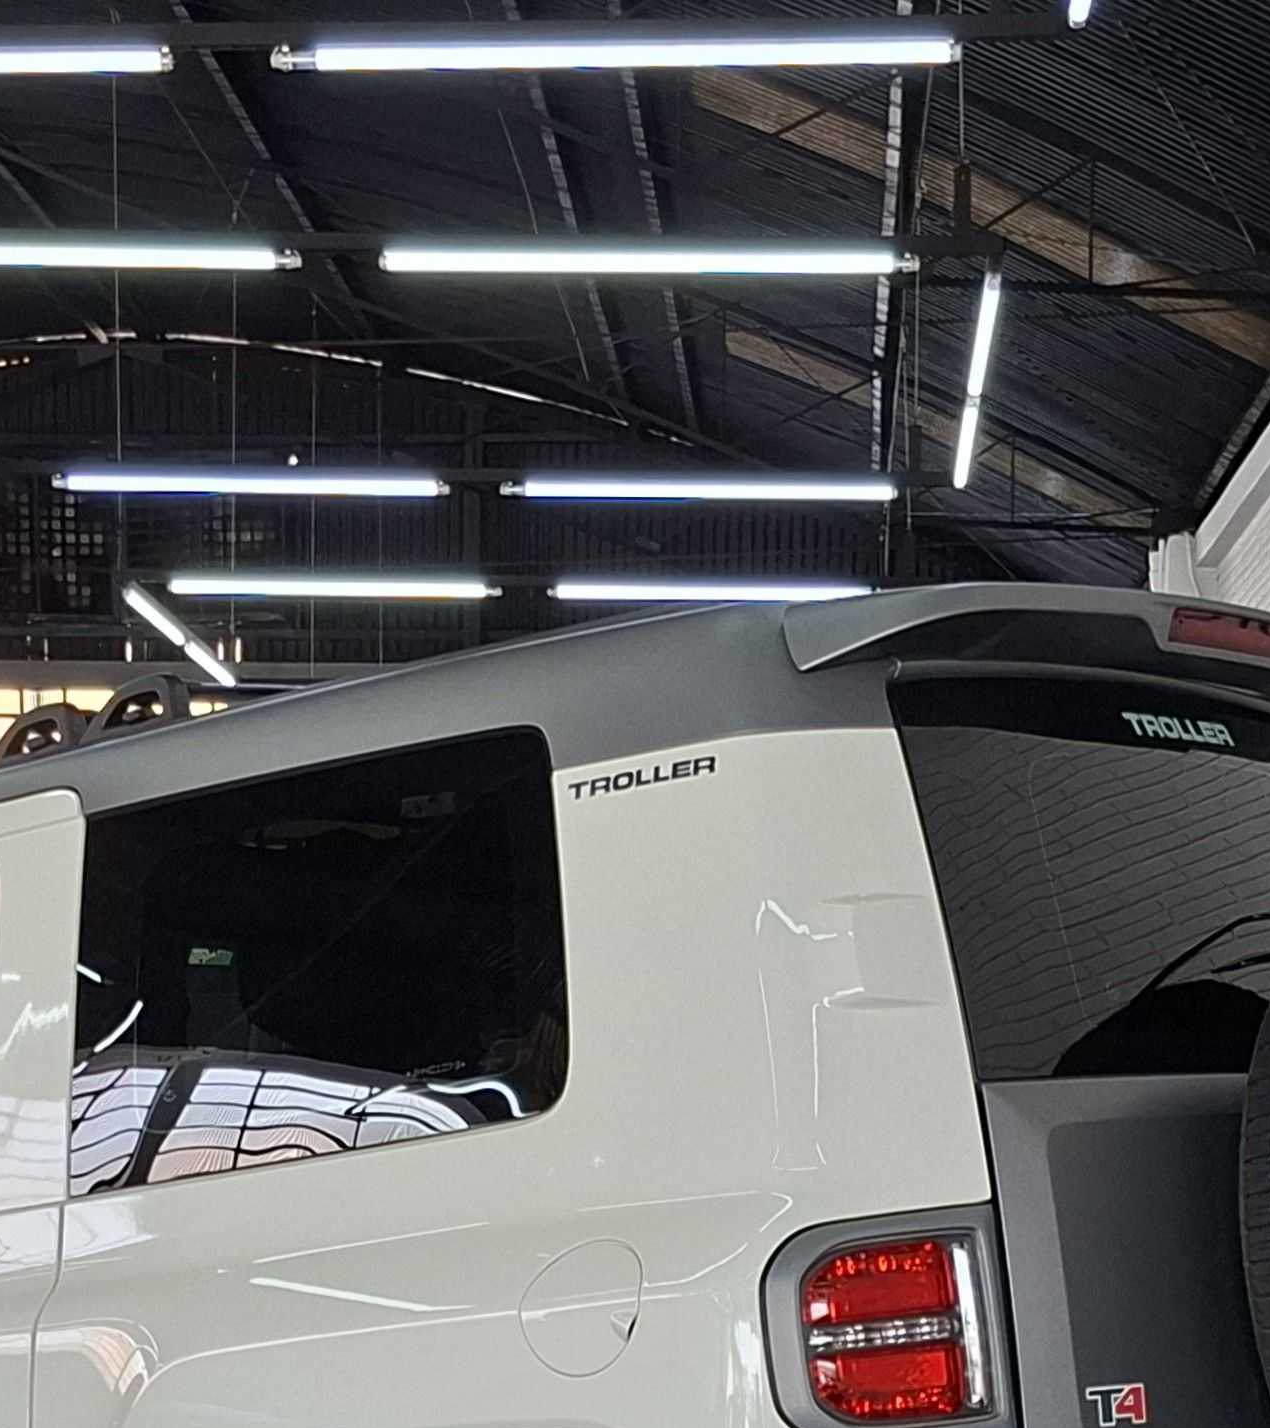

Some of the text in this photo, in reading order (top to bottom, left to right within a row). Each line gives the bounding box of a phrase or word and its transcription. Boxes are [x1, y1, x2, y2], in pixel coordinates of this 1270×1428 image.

[1122, 710, 1235, 748] TROLLER
[568, 755, 716, 800] TROLLER
[1085, 1383, 1146, 1428] T4
